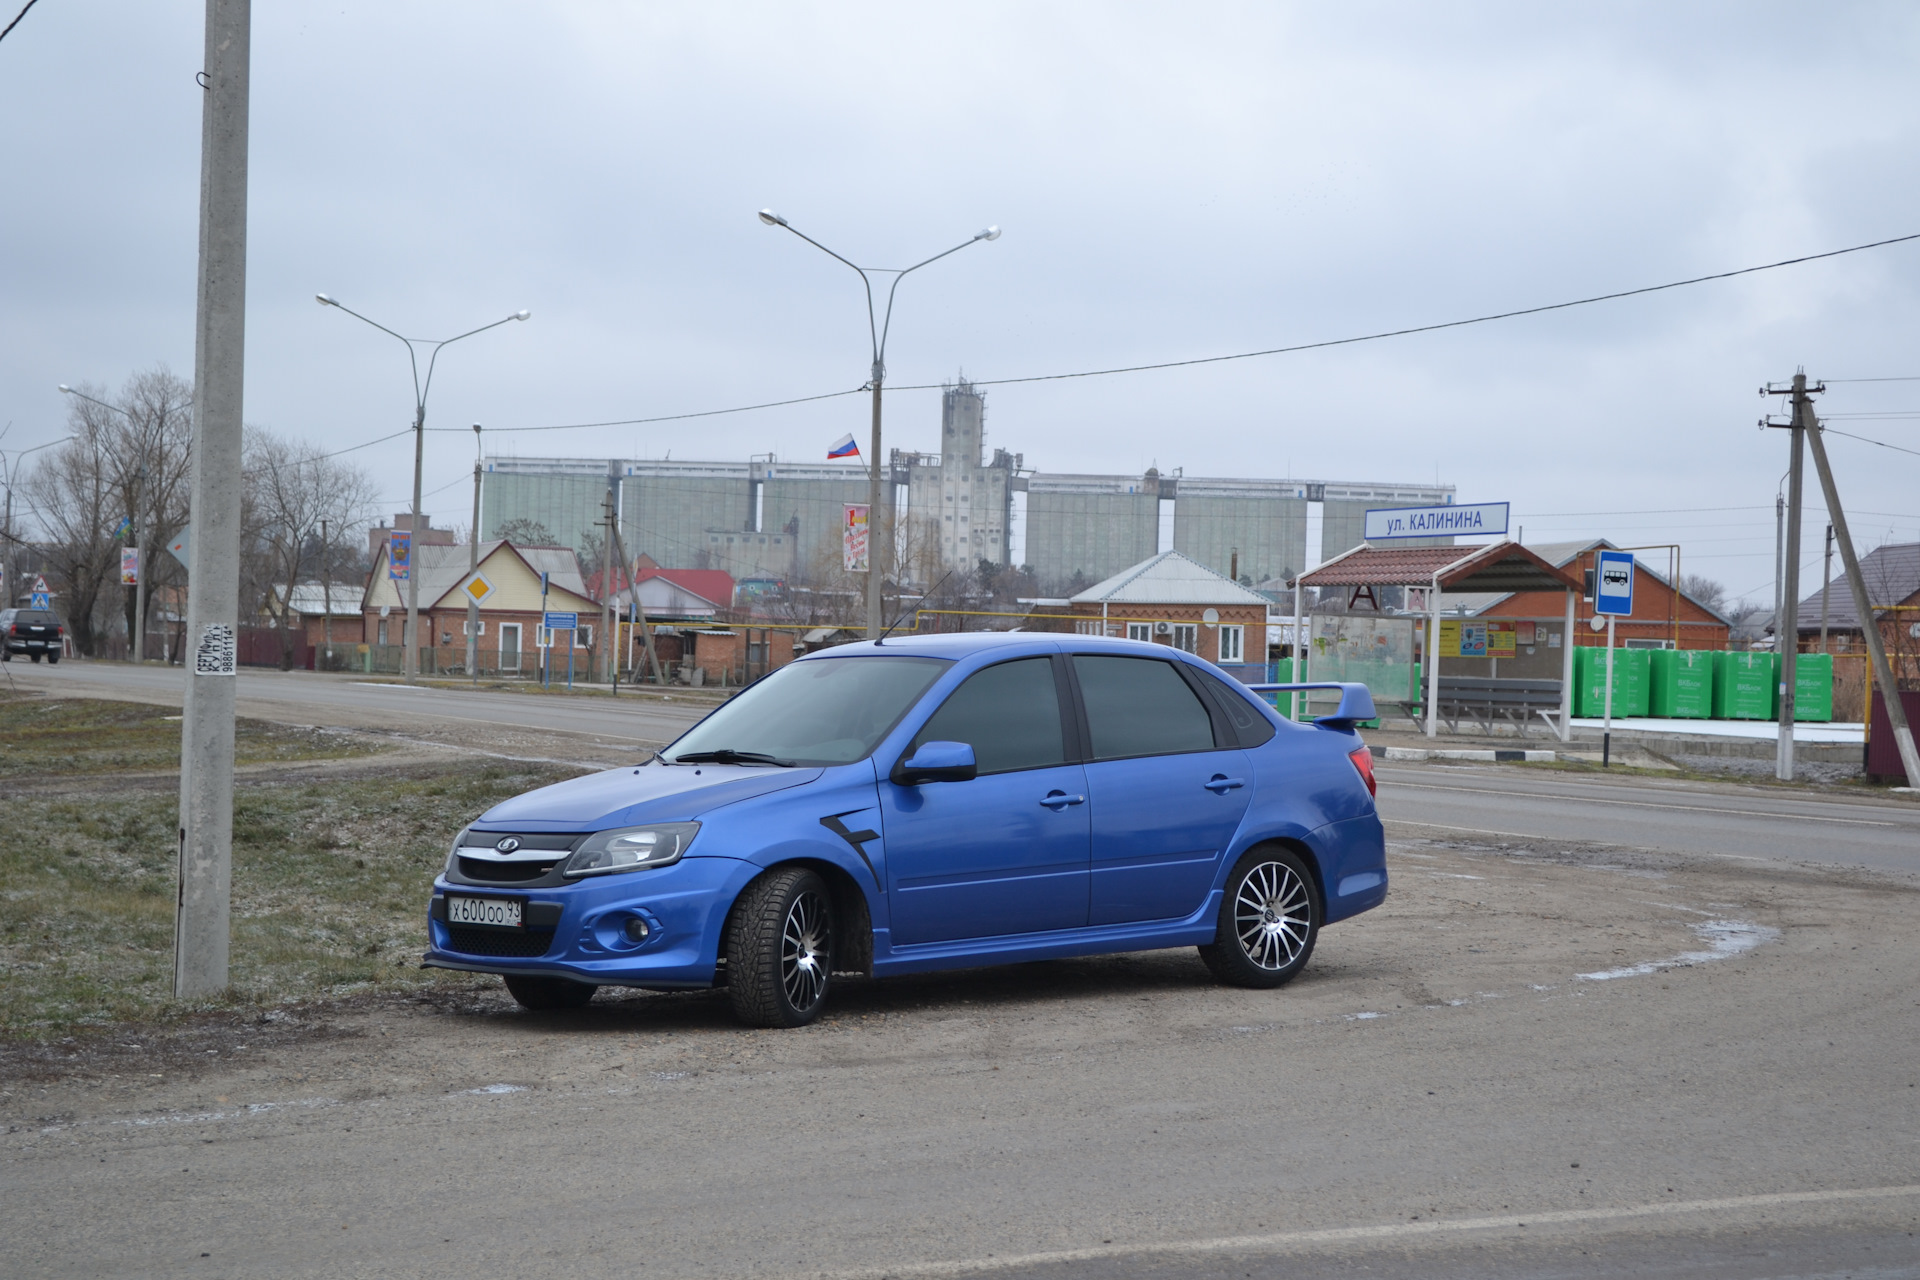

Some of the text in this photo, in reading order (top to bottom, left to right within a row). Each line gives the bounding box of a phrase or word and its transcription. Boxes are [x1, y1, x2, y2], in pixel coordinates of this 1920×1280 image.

[848, 509, 856, 527] 1
[1387, 510, 1483, 535] ул. КАЛИНИНА
[507, 901, 521, 918] 93
